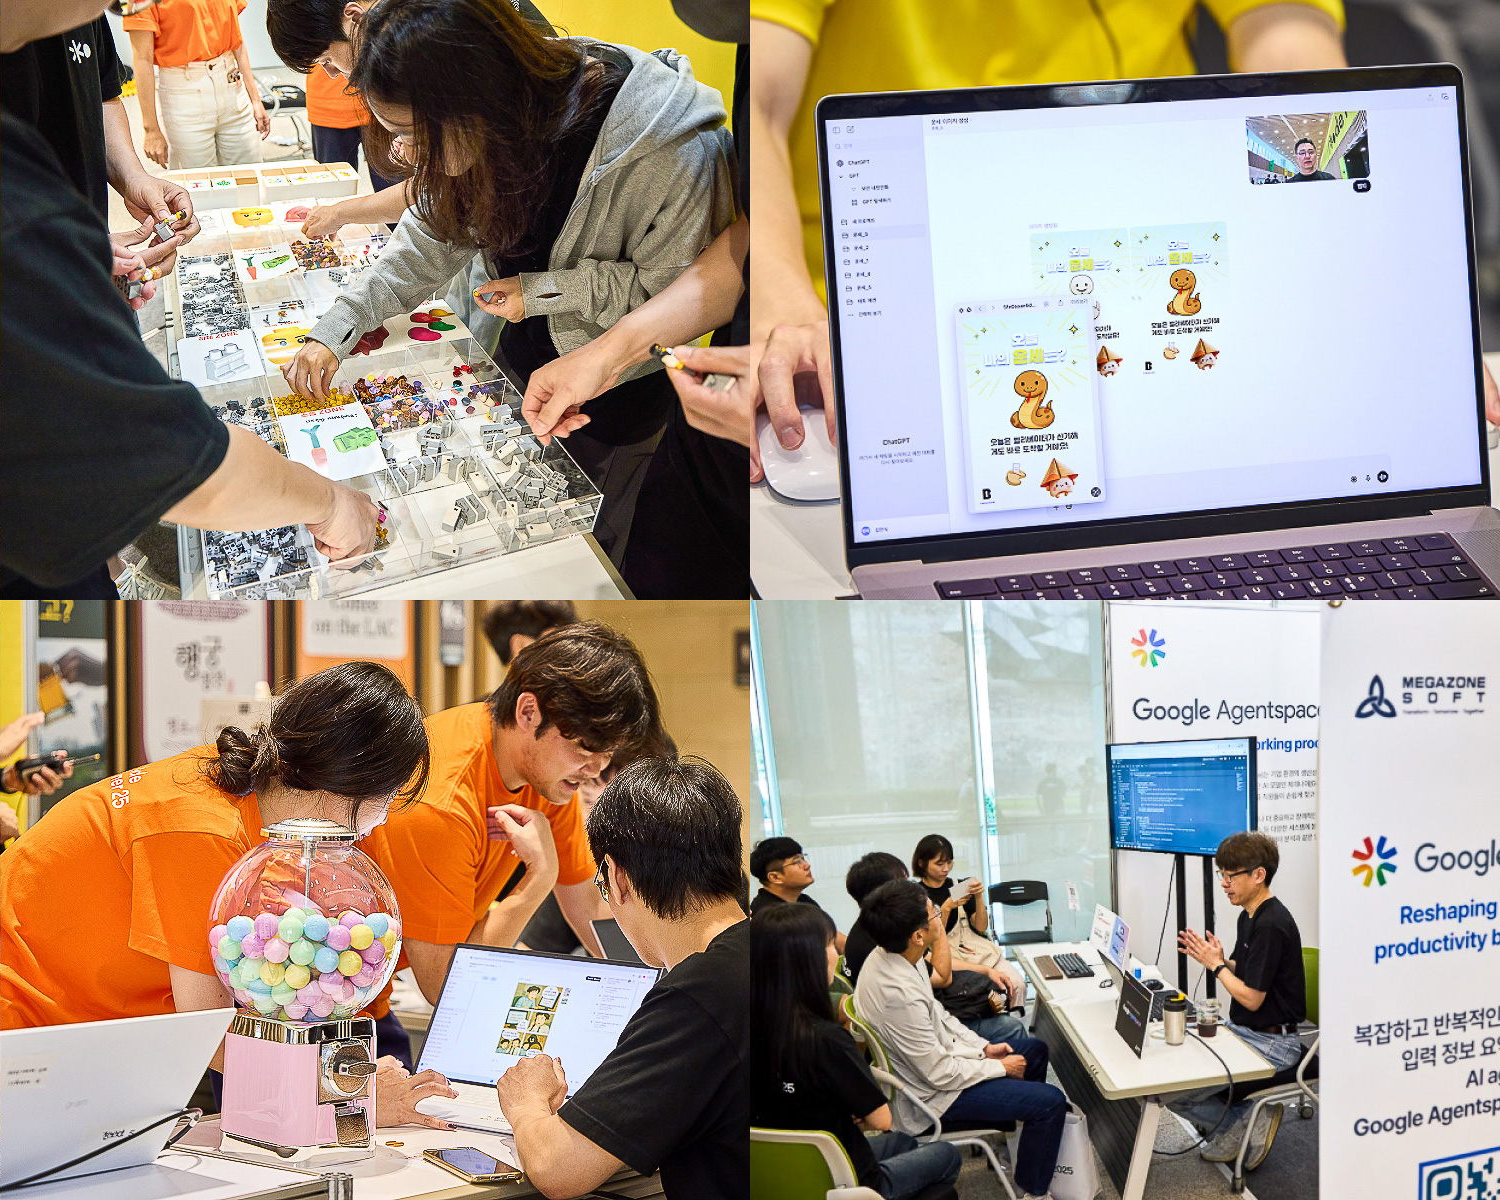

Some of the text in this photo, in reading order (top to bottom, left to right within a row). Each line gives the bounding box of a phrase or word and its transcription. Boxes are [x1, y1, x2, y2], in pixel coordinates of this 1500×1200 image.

[1068, 246, 1091, 258] 오늘
[1167, 239, 1190, 251] 오늘
[1046, 257, 1113, 273] 나의 운세는?
[1145, 251, 1212, 267] 나의 운세는?
[1011, 332, 1039, 347] 오늘
[984, 348, 1067, 367] 나의 운세는?
[882, 437, 910, 446] ChatGPT
[1402, 676, 1486, 689] MEGAZONE
[1133, 698, 1210, 726] Google
[111, 789, 130, 809] 25
[1400, 899, 1498, 925] Reshaping
[1374, 931, 1488, 965] productivity
[1354, 1005, 1500, 1047] 복잡하고 반복적인
[1402, 1040, 1476, 1072] 입력 정보
[1466, 1068, 1484, 1089] AI
[1353, 1110, 1424, 1137] Google
